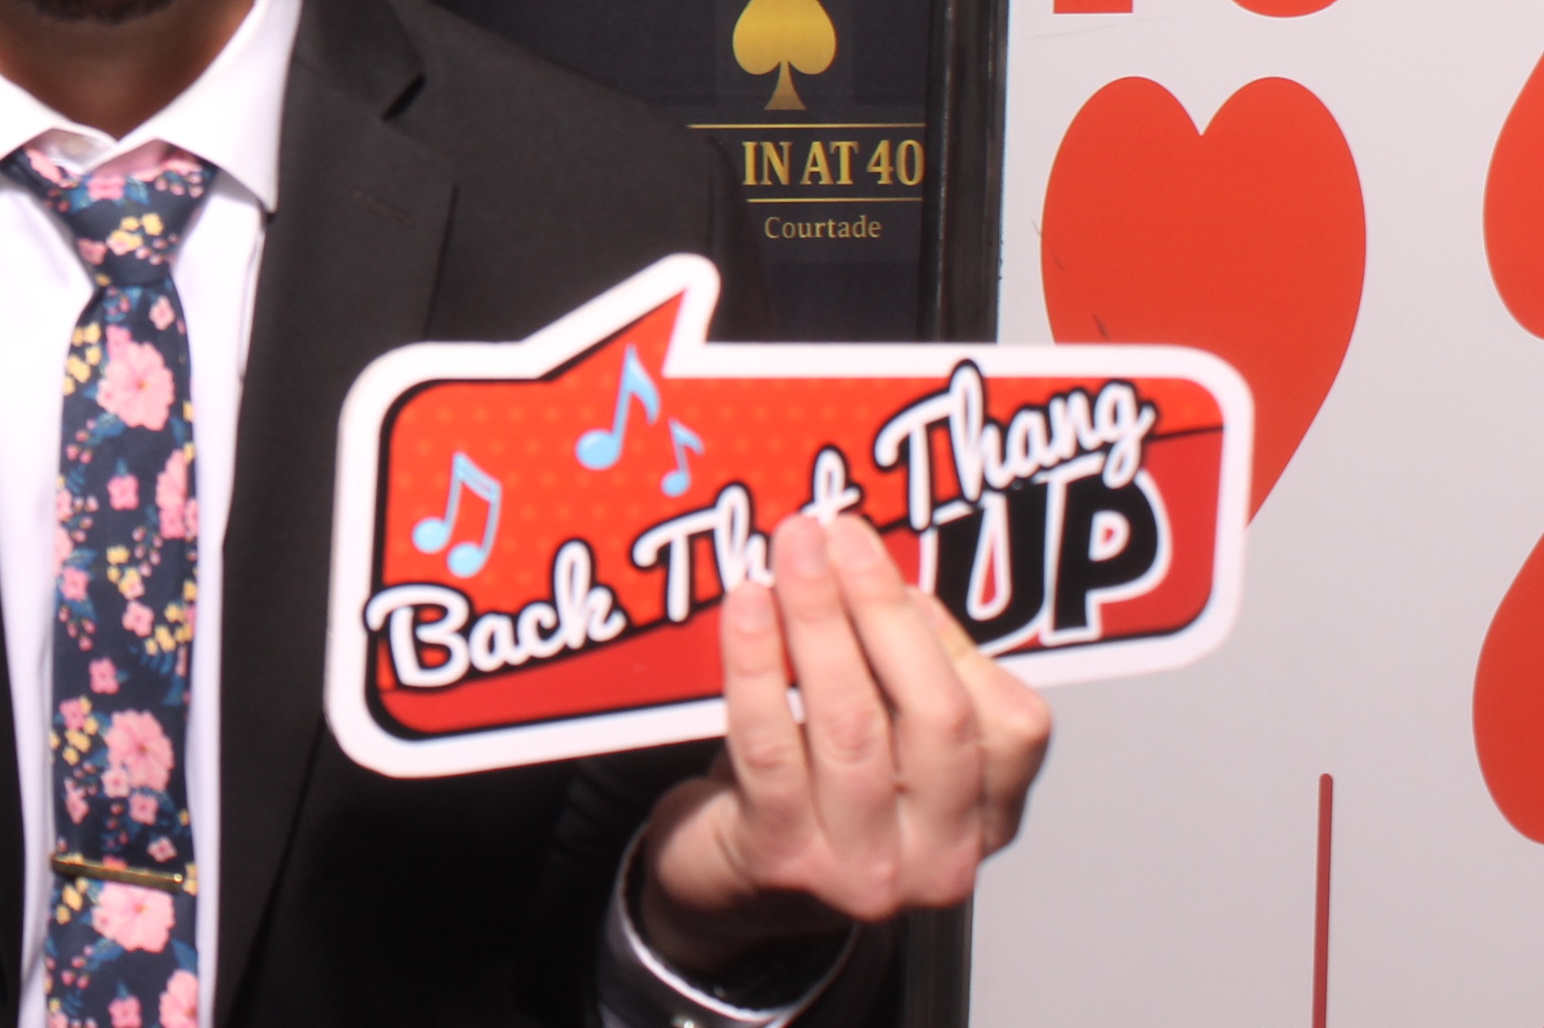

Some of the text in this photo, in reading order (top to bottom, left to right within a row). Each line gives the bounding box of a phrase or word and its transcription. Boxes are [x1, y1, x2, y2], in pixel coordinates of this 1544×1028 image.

[742, 139, 925, 186] IN AT 40
[764, 215, 882, 239] Courtade
[364, 358, 1159, 690] Back Tht Thang
[919, 452, 1172, 656] UP
